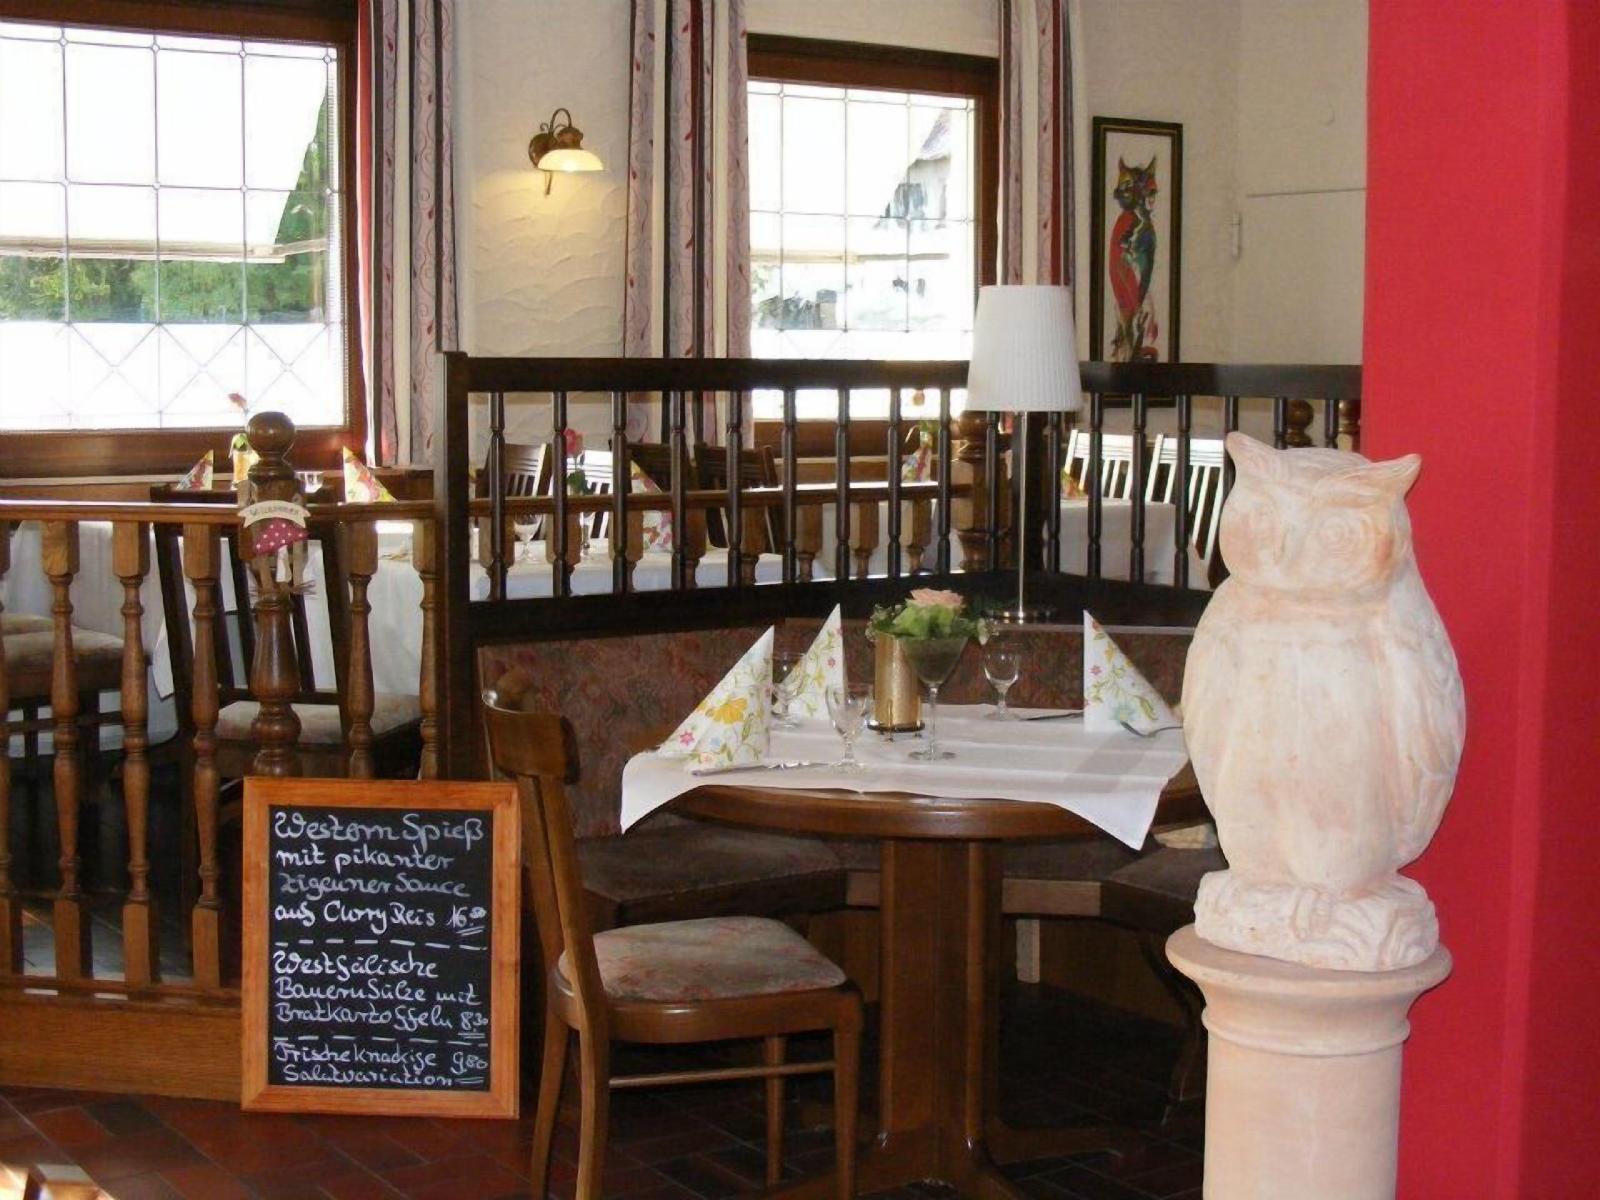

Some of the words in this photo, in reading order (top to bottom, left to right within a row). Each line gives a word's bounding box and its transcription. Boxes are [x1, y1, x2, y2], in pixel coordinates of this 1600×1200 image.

[402, 813, 484, 853] Spieß
[276, 843, 326, 867] mit
[334, 843, 454, 874] pikanter
[394, 872, 470, 897] Sauce
[275, 901, 316, 927] auf
[323, 900, 387, 935] Curry
[389, 902, 436, 926] Reis
[272, 950, 439, 982] Westfälische
[436, 983, 483, 1006] mit
[275, 1001, 453, 1032] Bratkartoffeln
[274, 1041, 350, 1063] Frische
[283, 1064, 452, 1085] Salatvariation
